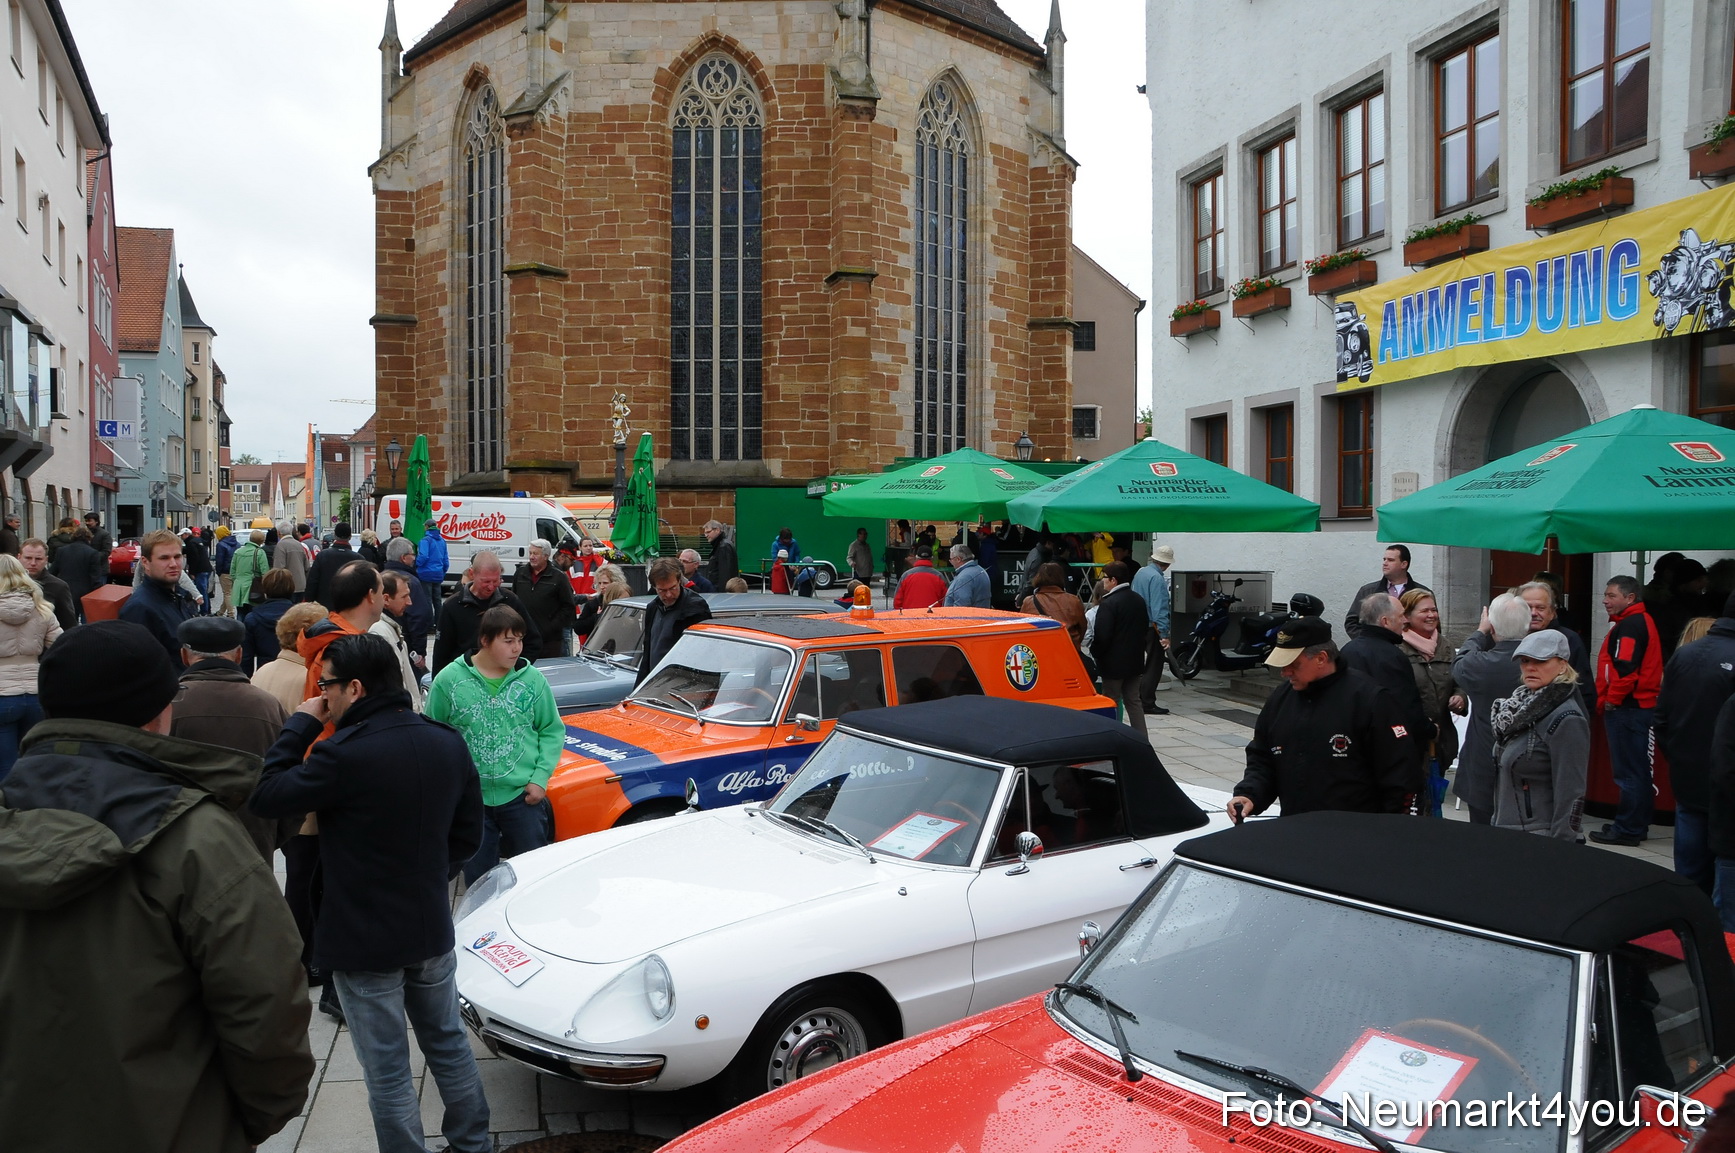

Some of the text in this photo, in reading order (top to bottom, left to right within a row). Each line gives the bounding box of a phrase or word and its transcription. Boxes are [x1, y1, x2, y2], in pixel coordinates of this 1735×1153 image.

[1378, 239, 1641, 365] ANMELDUNG
[1131, 478, 1208, 486] Neumarkter
[1117, 484, 1228, 494] Lammsbräu
[476, 530, 507, 539] IMBISS
[717, 770, 765, 795] Alfa
